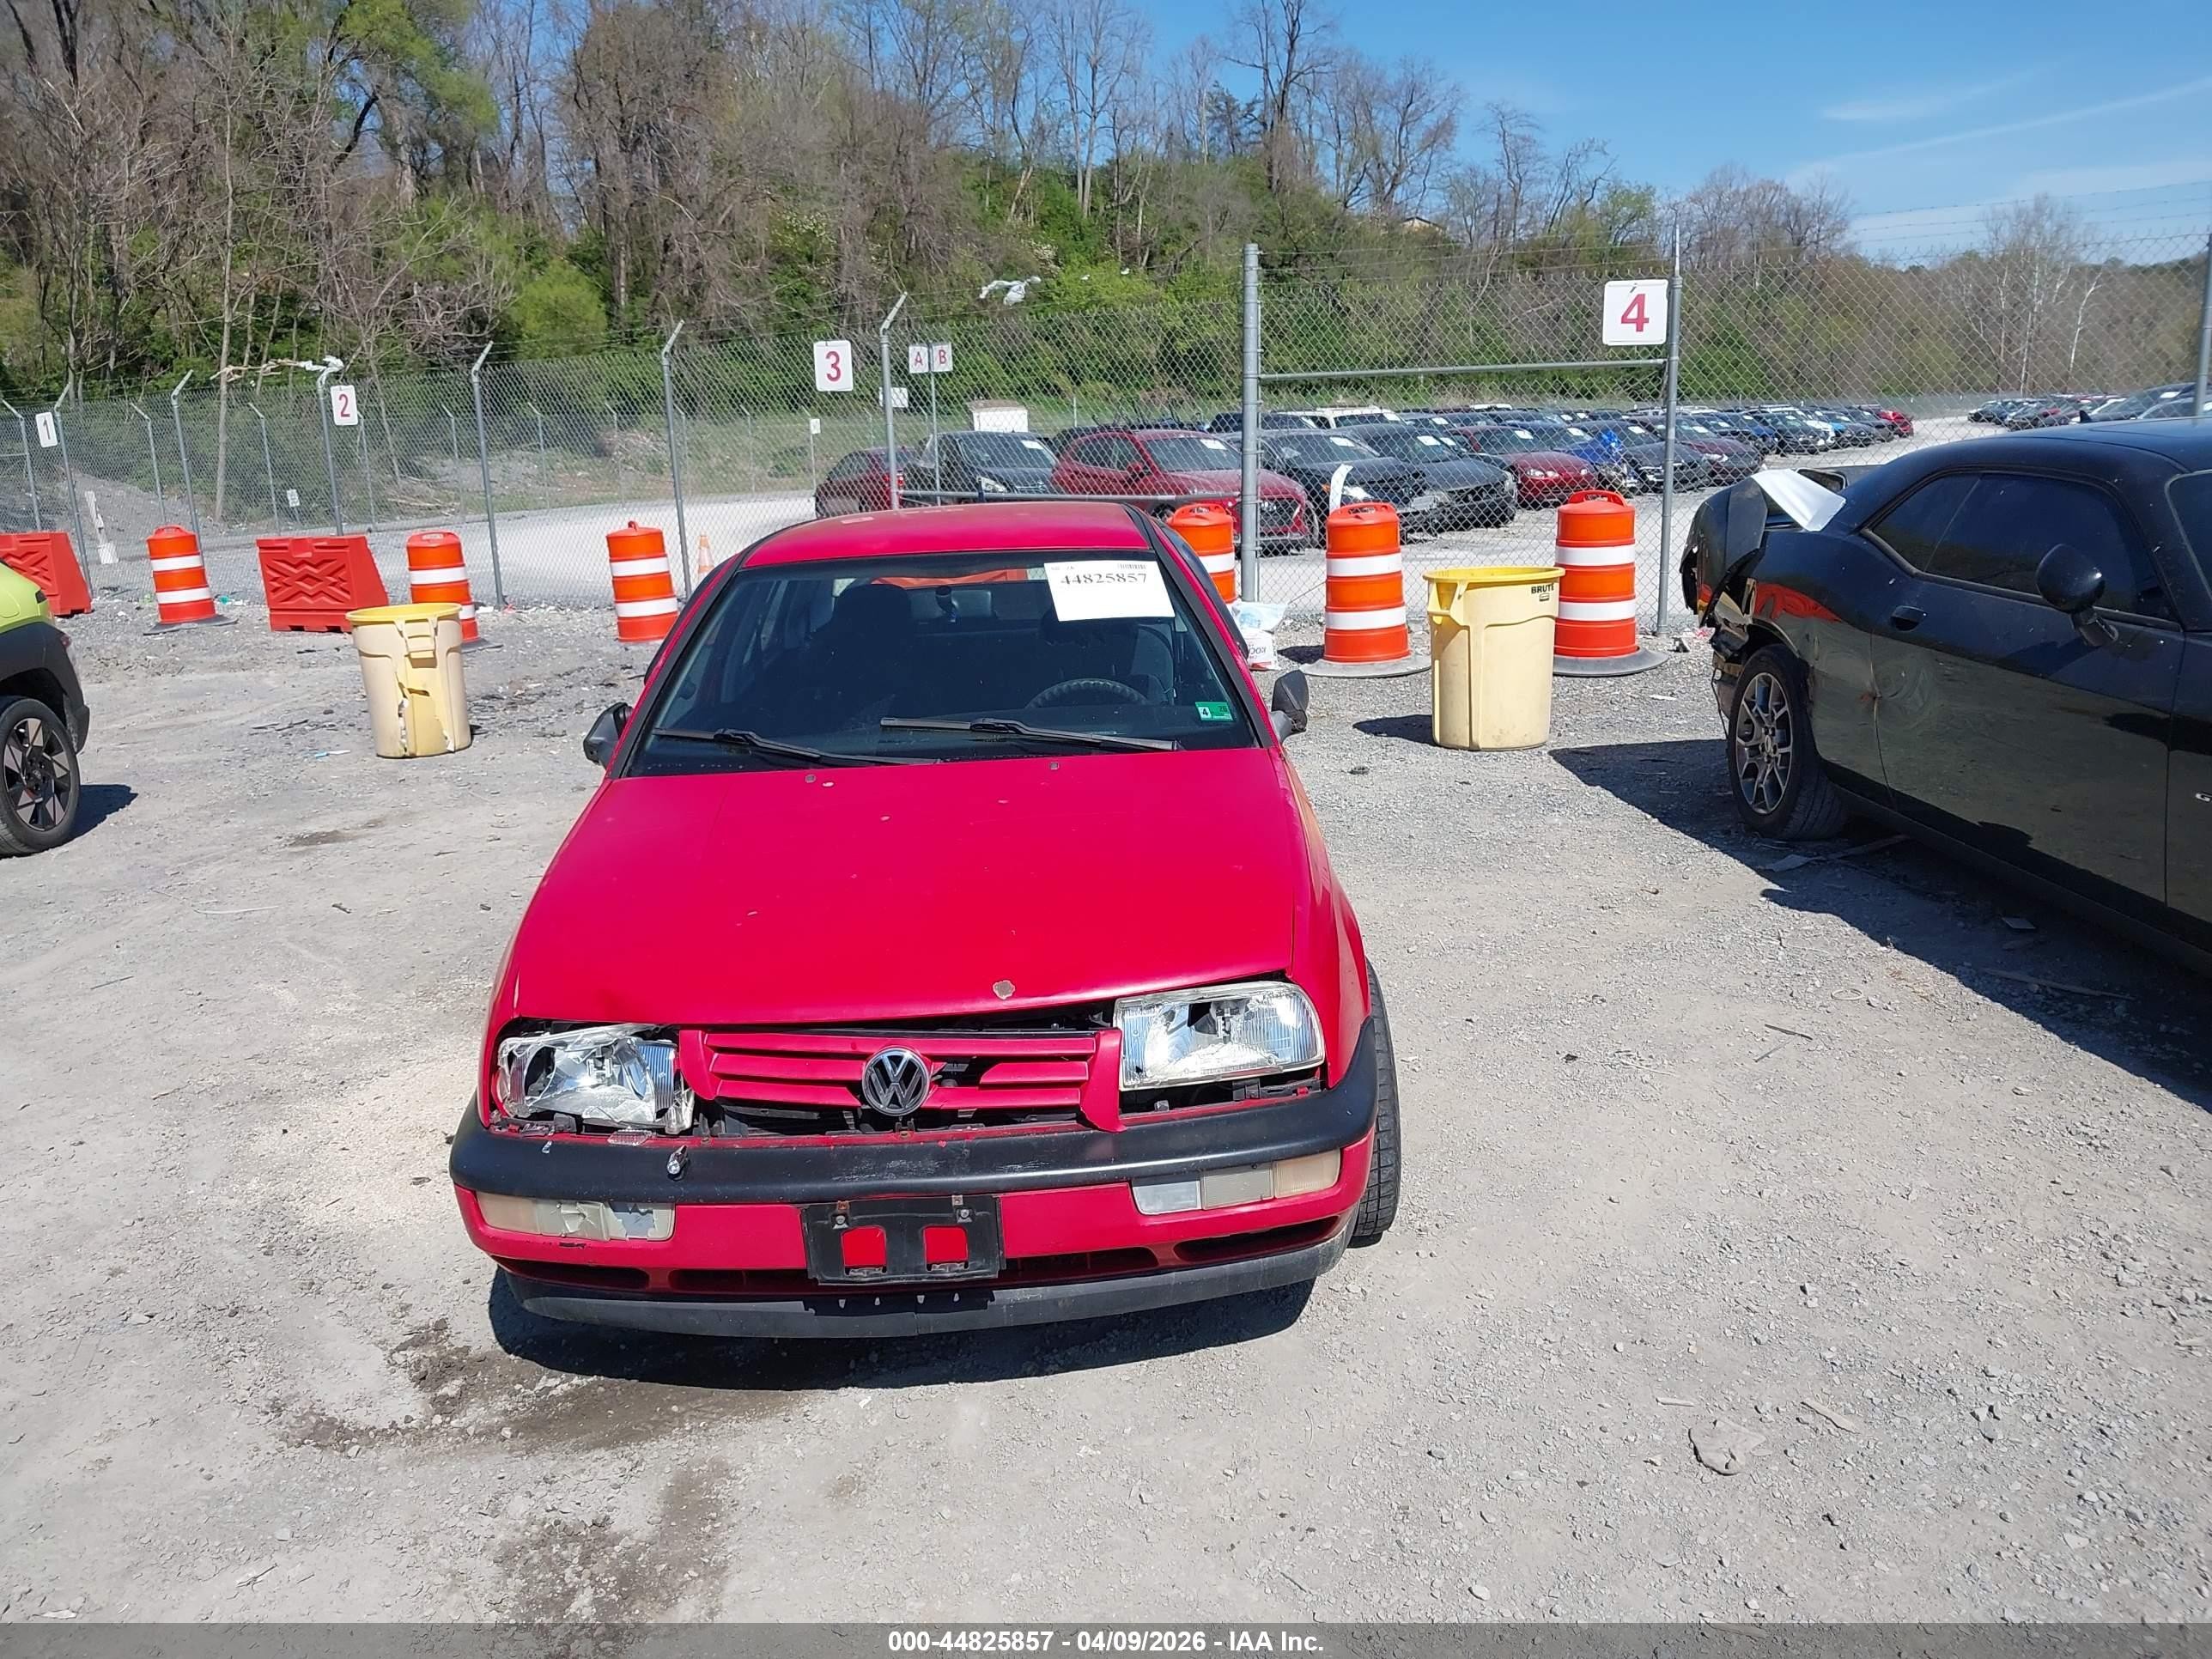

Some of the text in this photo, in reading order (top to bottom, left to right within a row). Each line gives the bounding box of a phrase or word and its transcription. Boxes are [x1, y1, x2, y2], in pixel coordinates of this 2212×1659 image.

[1621, 294, 1650, 332] 4
[825, 350, 842, 382] 3
[914, 351, 923, 367] A
[939, 349, 947, 364] B
[338, 393, 351, 417] 2
[43, 416, 51, 440] 1
[1060, 573, 1147, 585] 44825857
[1531, 582, 1554, 593] BRUTE
